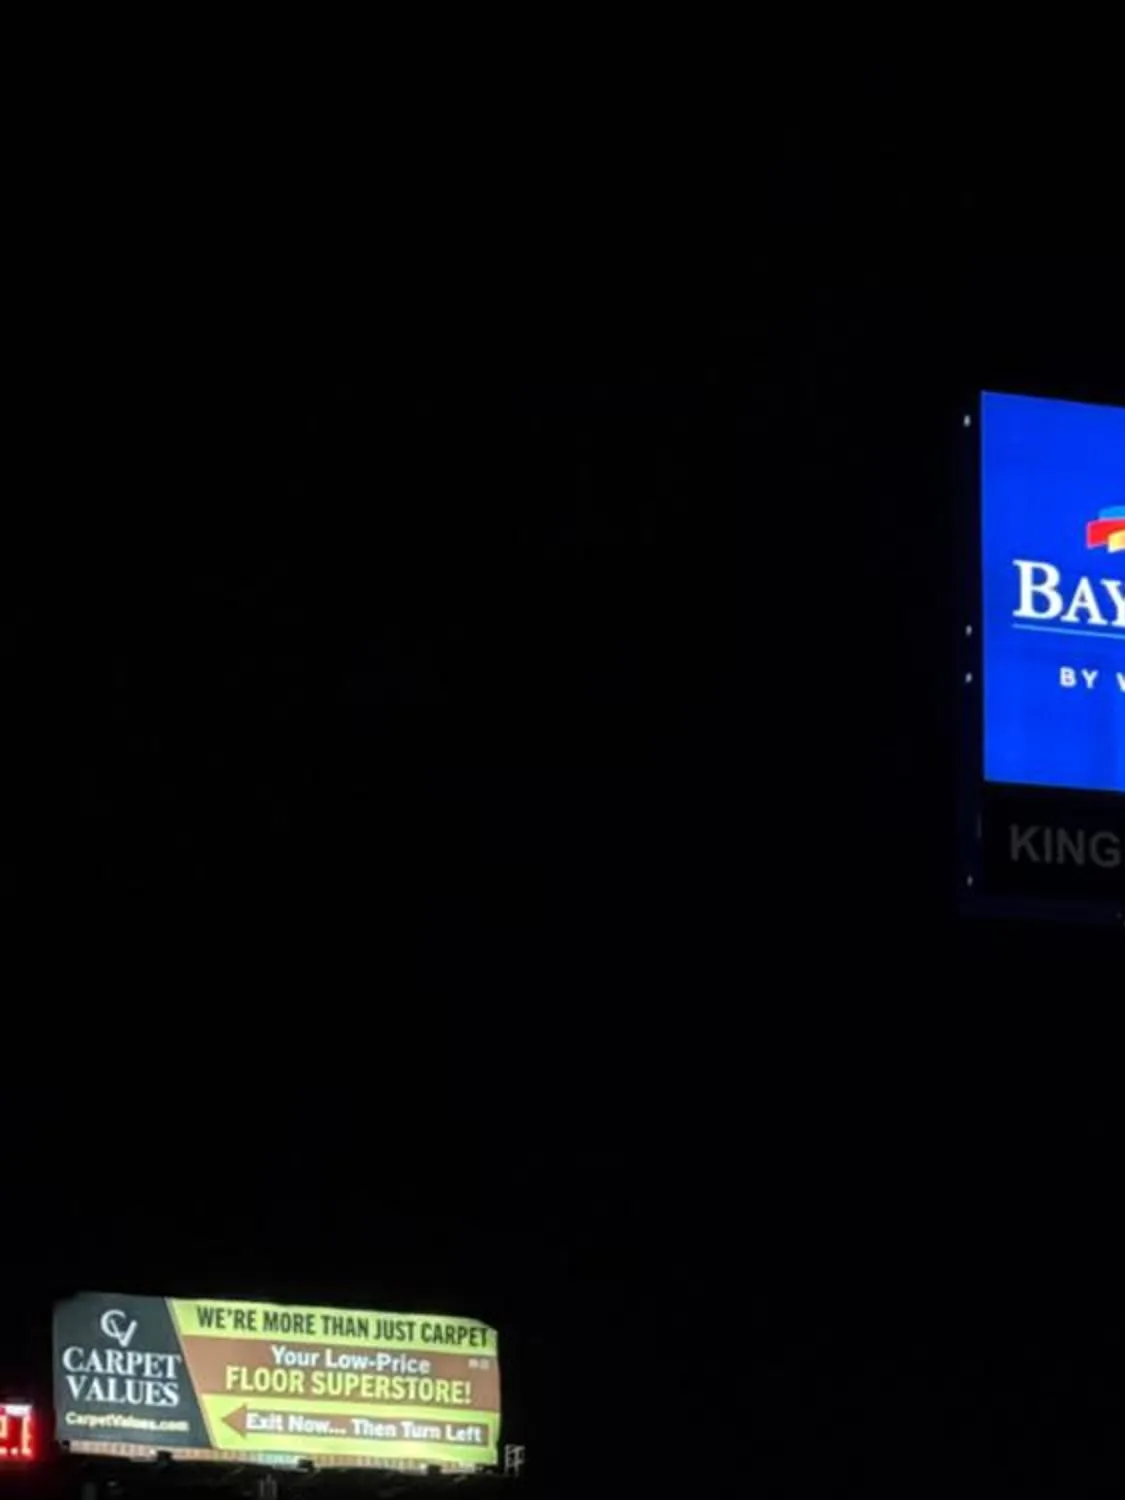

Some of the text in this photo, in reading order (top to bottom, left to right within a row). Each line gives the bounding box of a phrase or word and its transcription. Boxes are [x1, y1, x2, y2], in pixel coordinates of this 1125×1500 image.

[1059, 667, 1099, 689] BY
[196, 1306, 488, 1348] WE'RE MORE THAN JUST CARPET
[62, 1346, 182, 1379] CARPET
[271, 1344, 432, 1374] Your Low-Price
[65, 1375, 180, 1408] VALUES
[225, 1365, 472, 1405] FLOOR SUPERSTORE!
[245, 1412, 284, 1432] Exit
[351, 1418, 397, 1438] Then
[401, 1420, 442, 1440] Turn
[445, 1424, 482, 1443] Left
